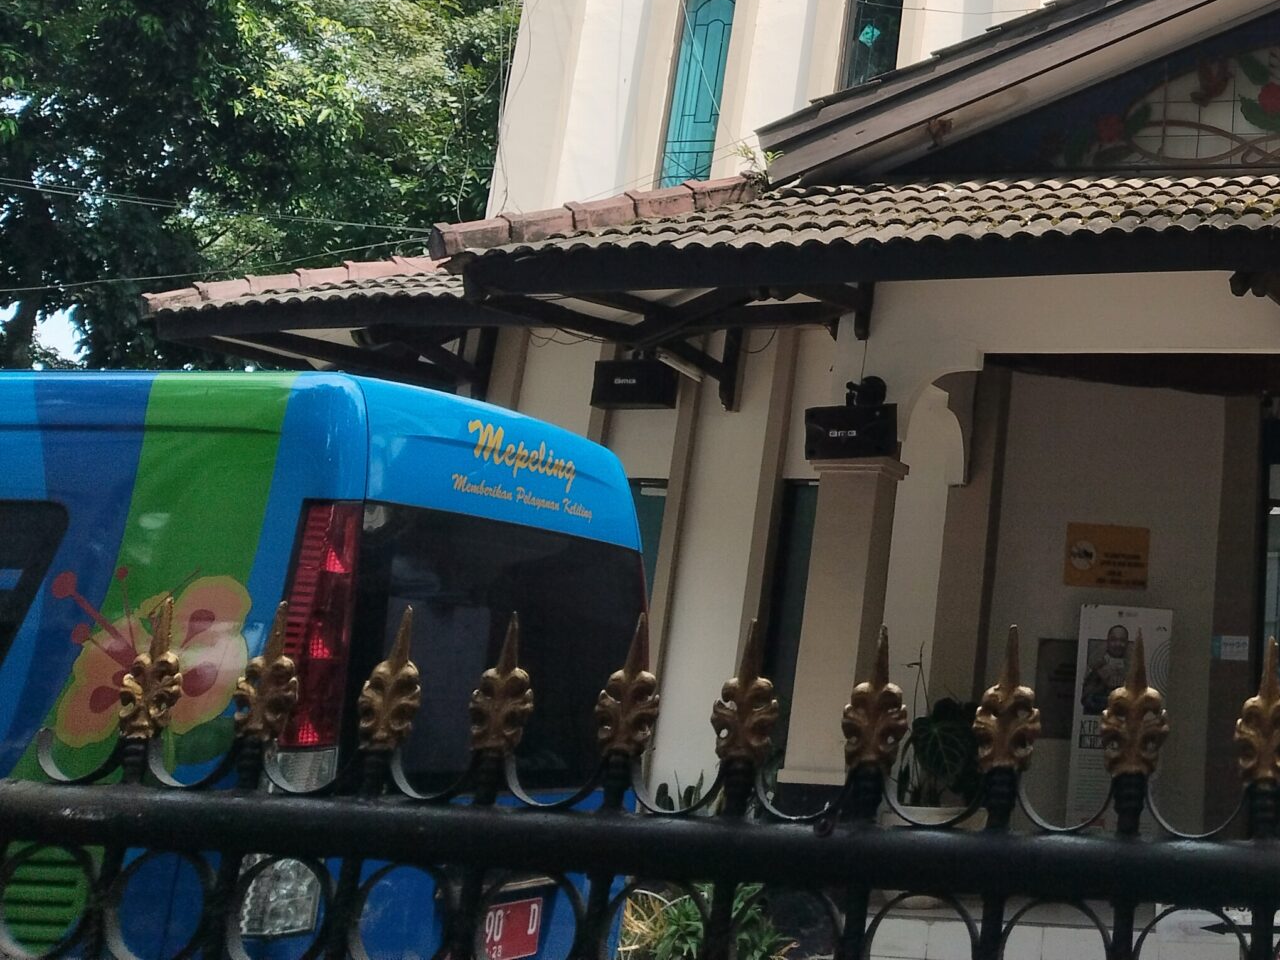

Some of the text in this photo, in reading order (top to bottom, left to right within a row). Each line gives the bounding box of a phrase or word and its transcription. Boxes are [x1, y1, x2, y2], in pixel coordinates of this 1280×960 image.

[468, 419, 577, 493] Mepeling
[452, 473, 513, 501] Memberikan
[516, 486, 560, 511] Pelayanan
[527, 903, 539, 935] D
